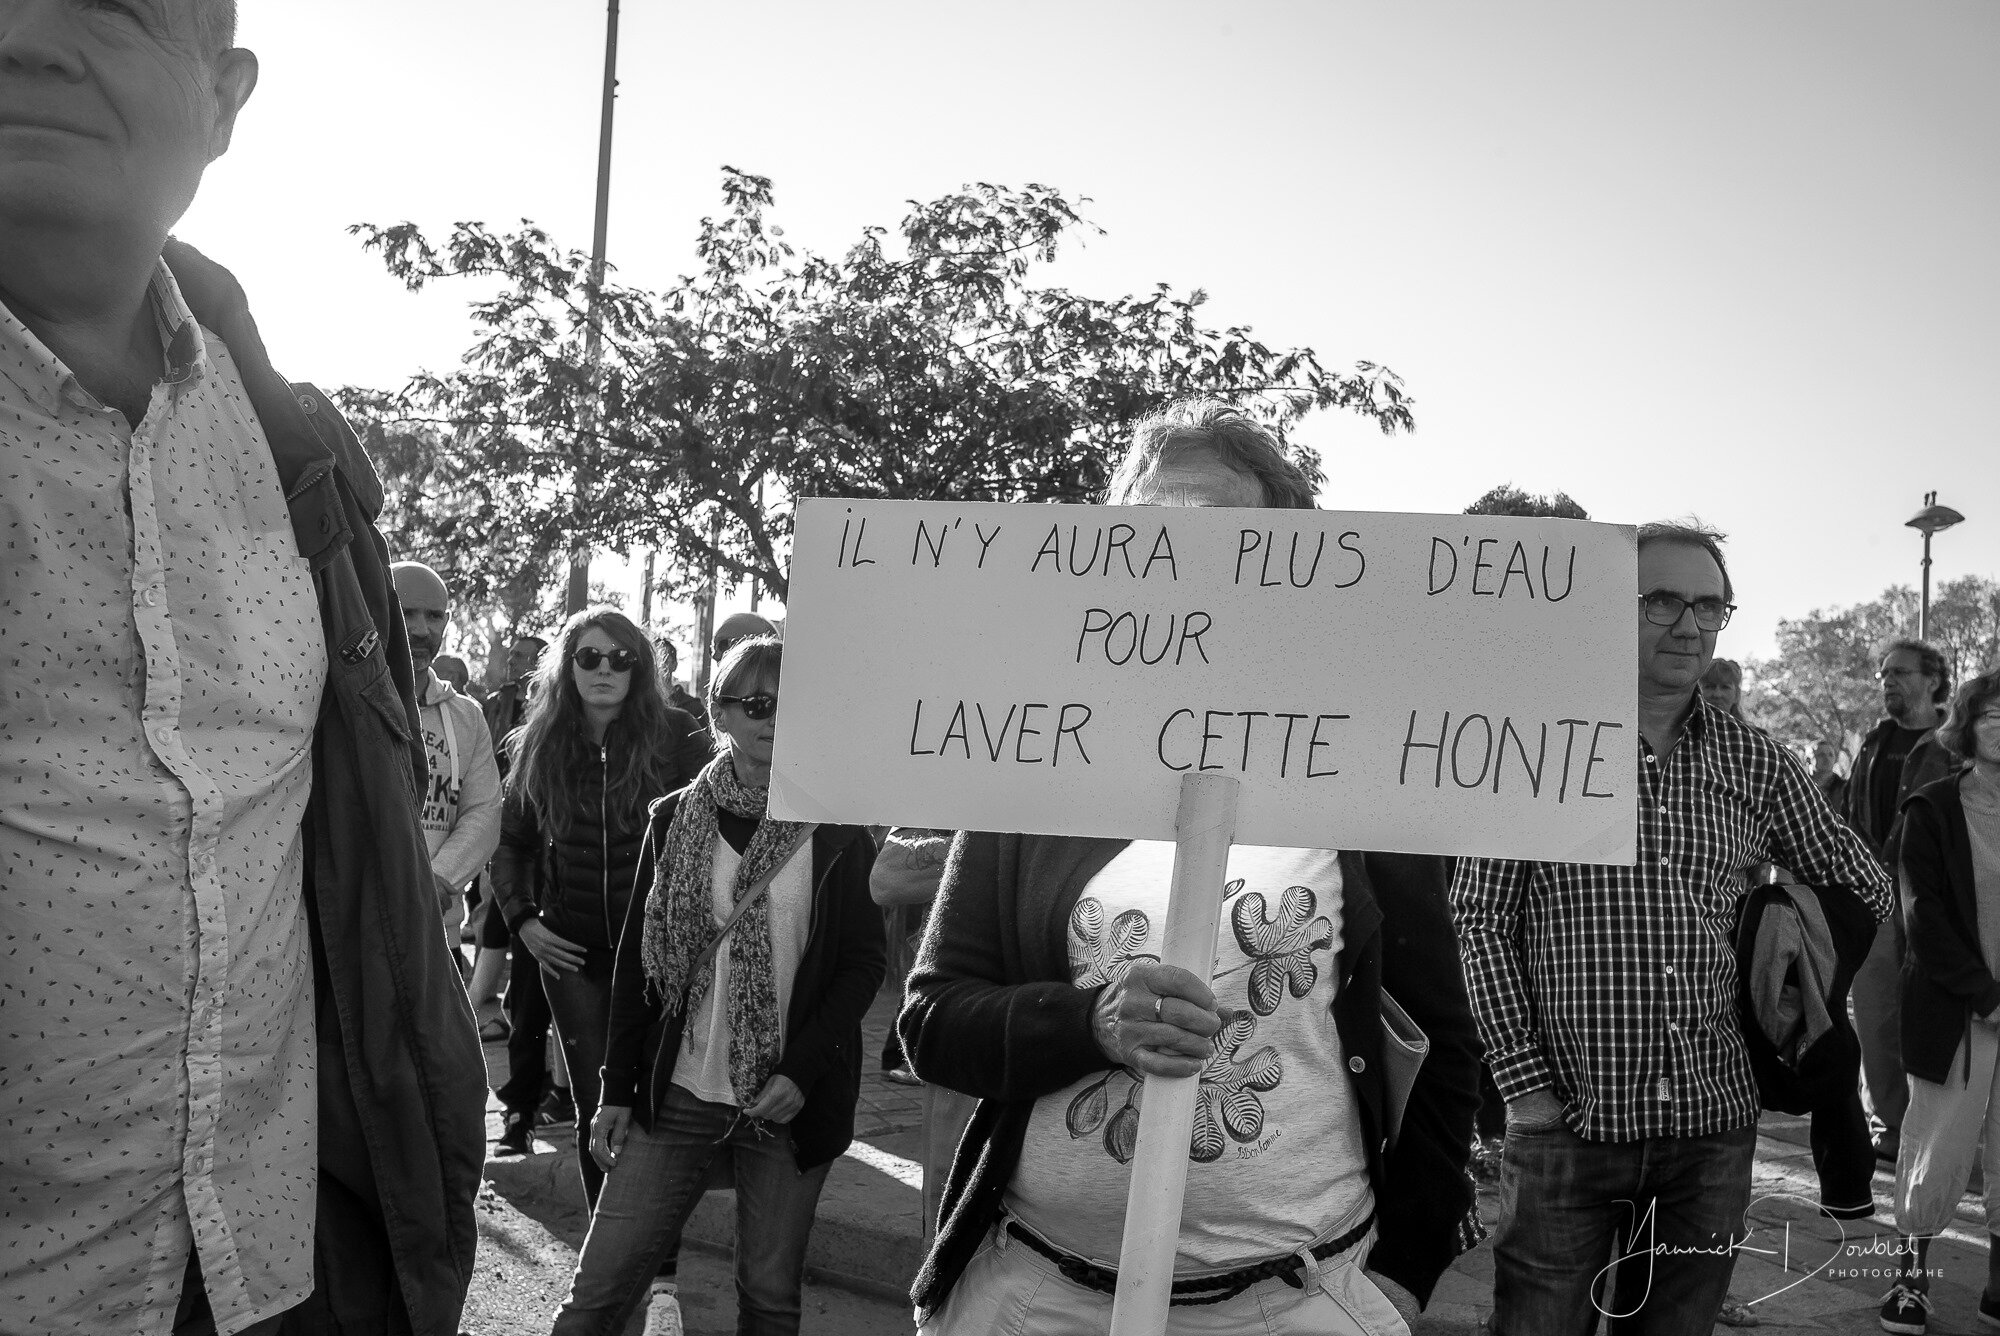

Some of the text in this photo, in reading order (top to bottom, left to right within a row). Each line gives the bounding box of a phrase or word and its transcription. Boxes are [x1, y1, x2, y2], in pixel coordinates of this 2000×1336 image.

[912, 516, 1002, 569] N'Y
[1031, 523, 1178, 581] AURA
[1234, 529, 1366, 589] PLUS
[1426, 535, 1576, 603] D'EAU
[1076, 608, 1212, 666] POUR
[910, 698, 1623, 804] LAVER CETTE HONTE
